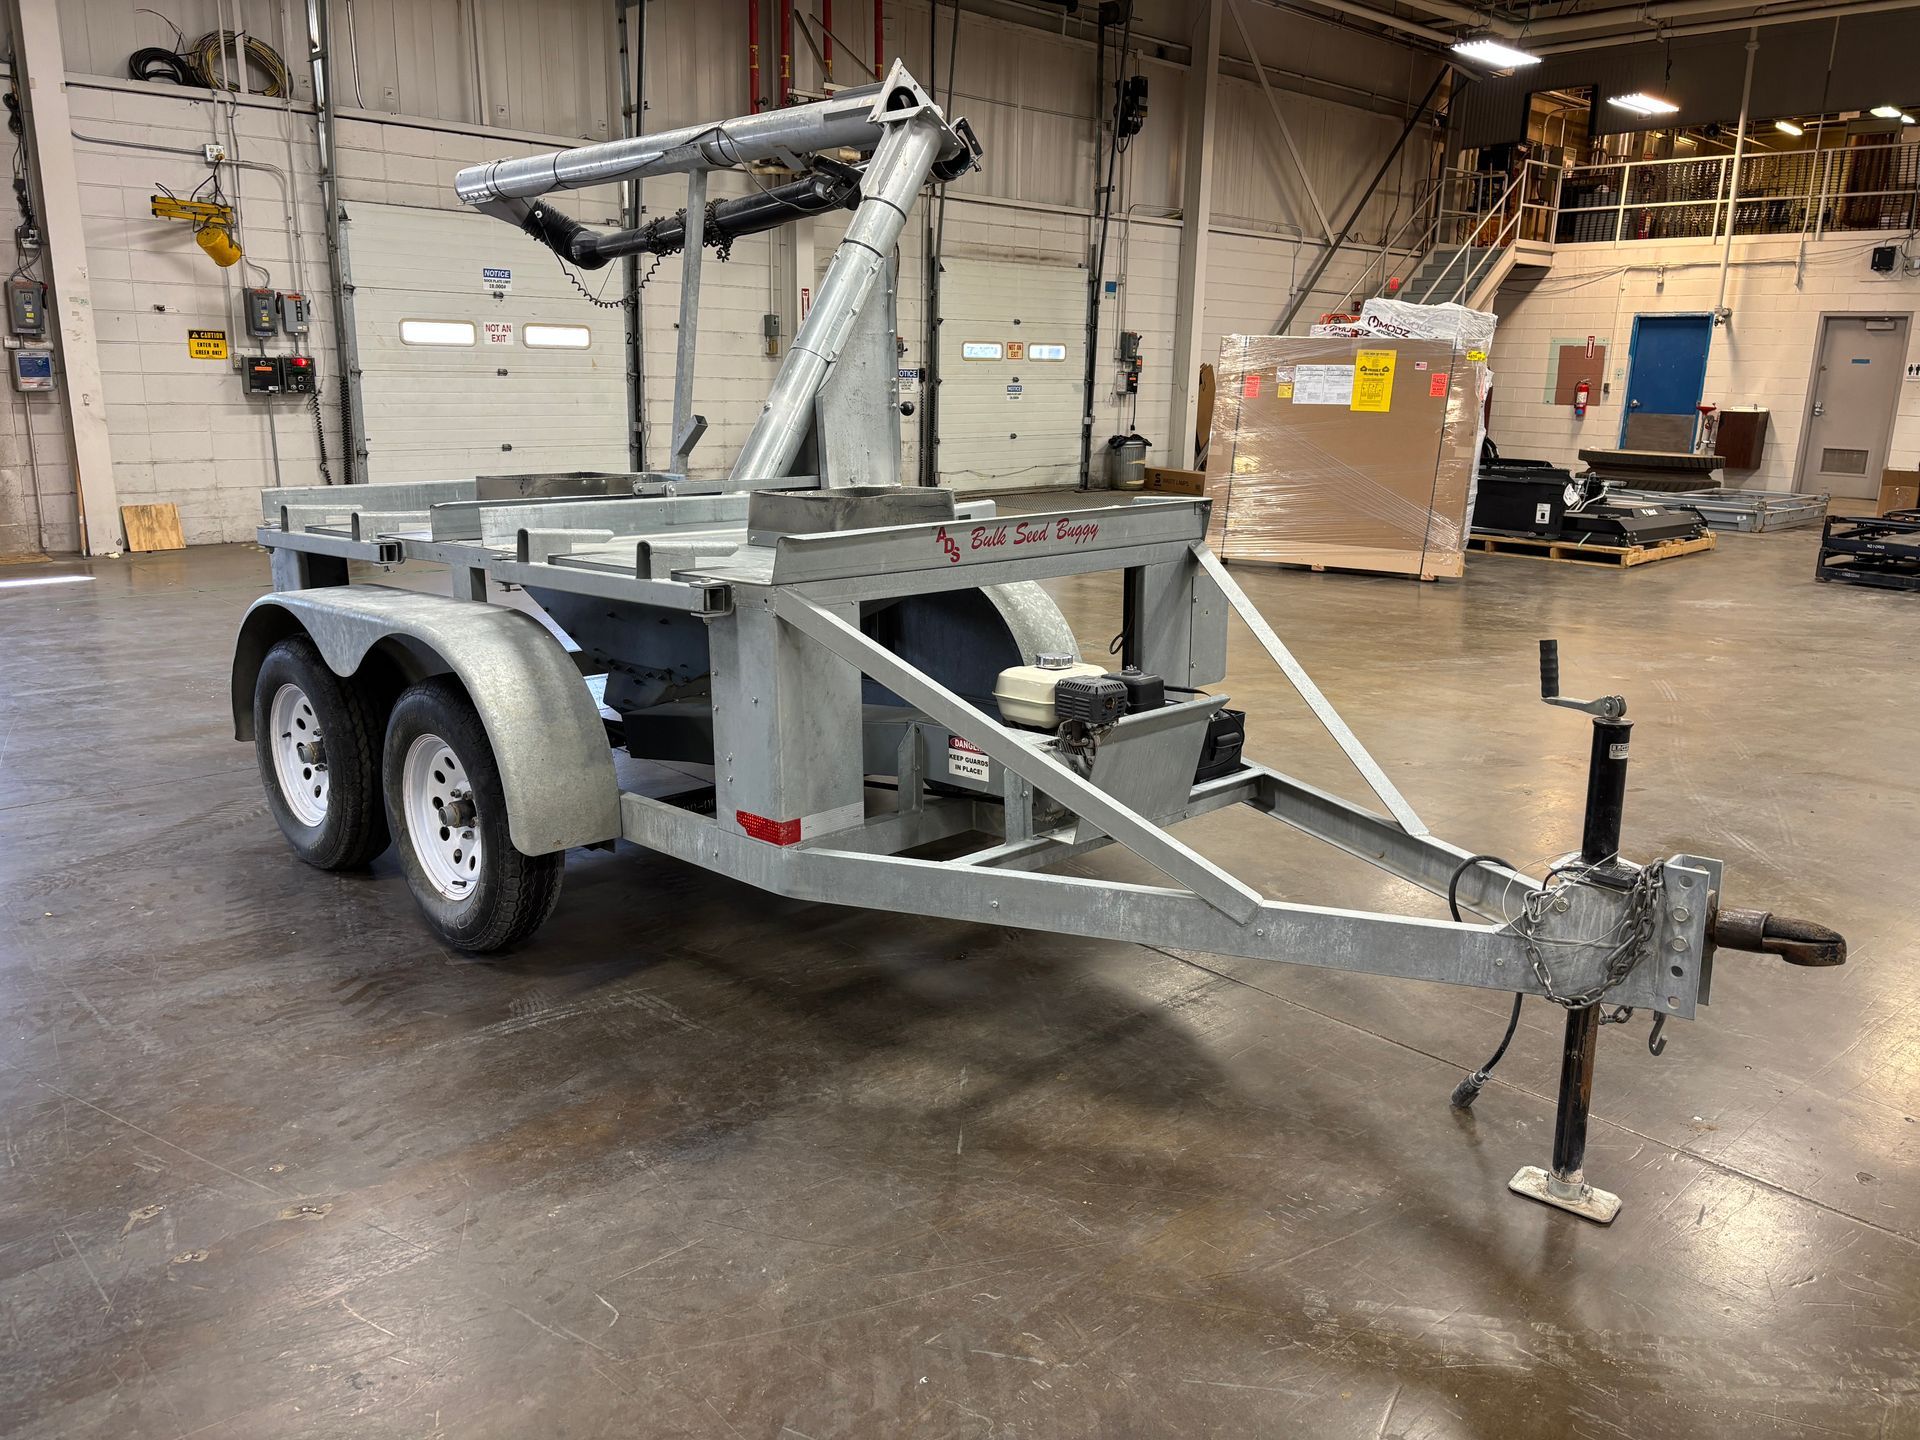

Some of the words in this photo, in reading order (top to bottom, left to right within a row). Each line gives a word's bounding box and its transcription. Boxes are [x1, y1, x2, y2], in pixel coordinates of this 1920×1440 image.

[484, 269, 510, 278] NOTICE
[485, 324, 500, 333] NOT
[502, 325, 511, 333] AN
[1379, 321, 1411, 338] MODZ
[200, 331, 223, 339] CAUTION
[491, 335, 507, 343] EXIT
[626, 331, 633, 345] 2
[971, 525, 1008, 550] Bulk
[1013, 522, 1050, 545] Seed
[1056, 517, 1099, 545] Buggy
[954, 739, 981, 751] DANG
[965, 757, 989, 767] GUARDS
[963, 766, 983, 775] PLACE!
